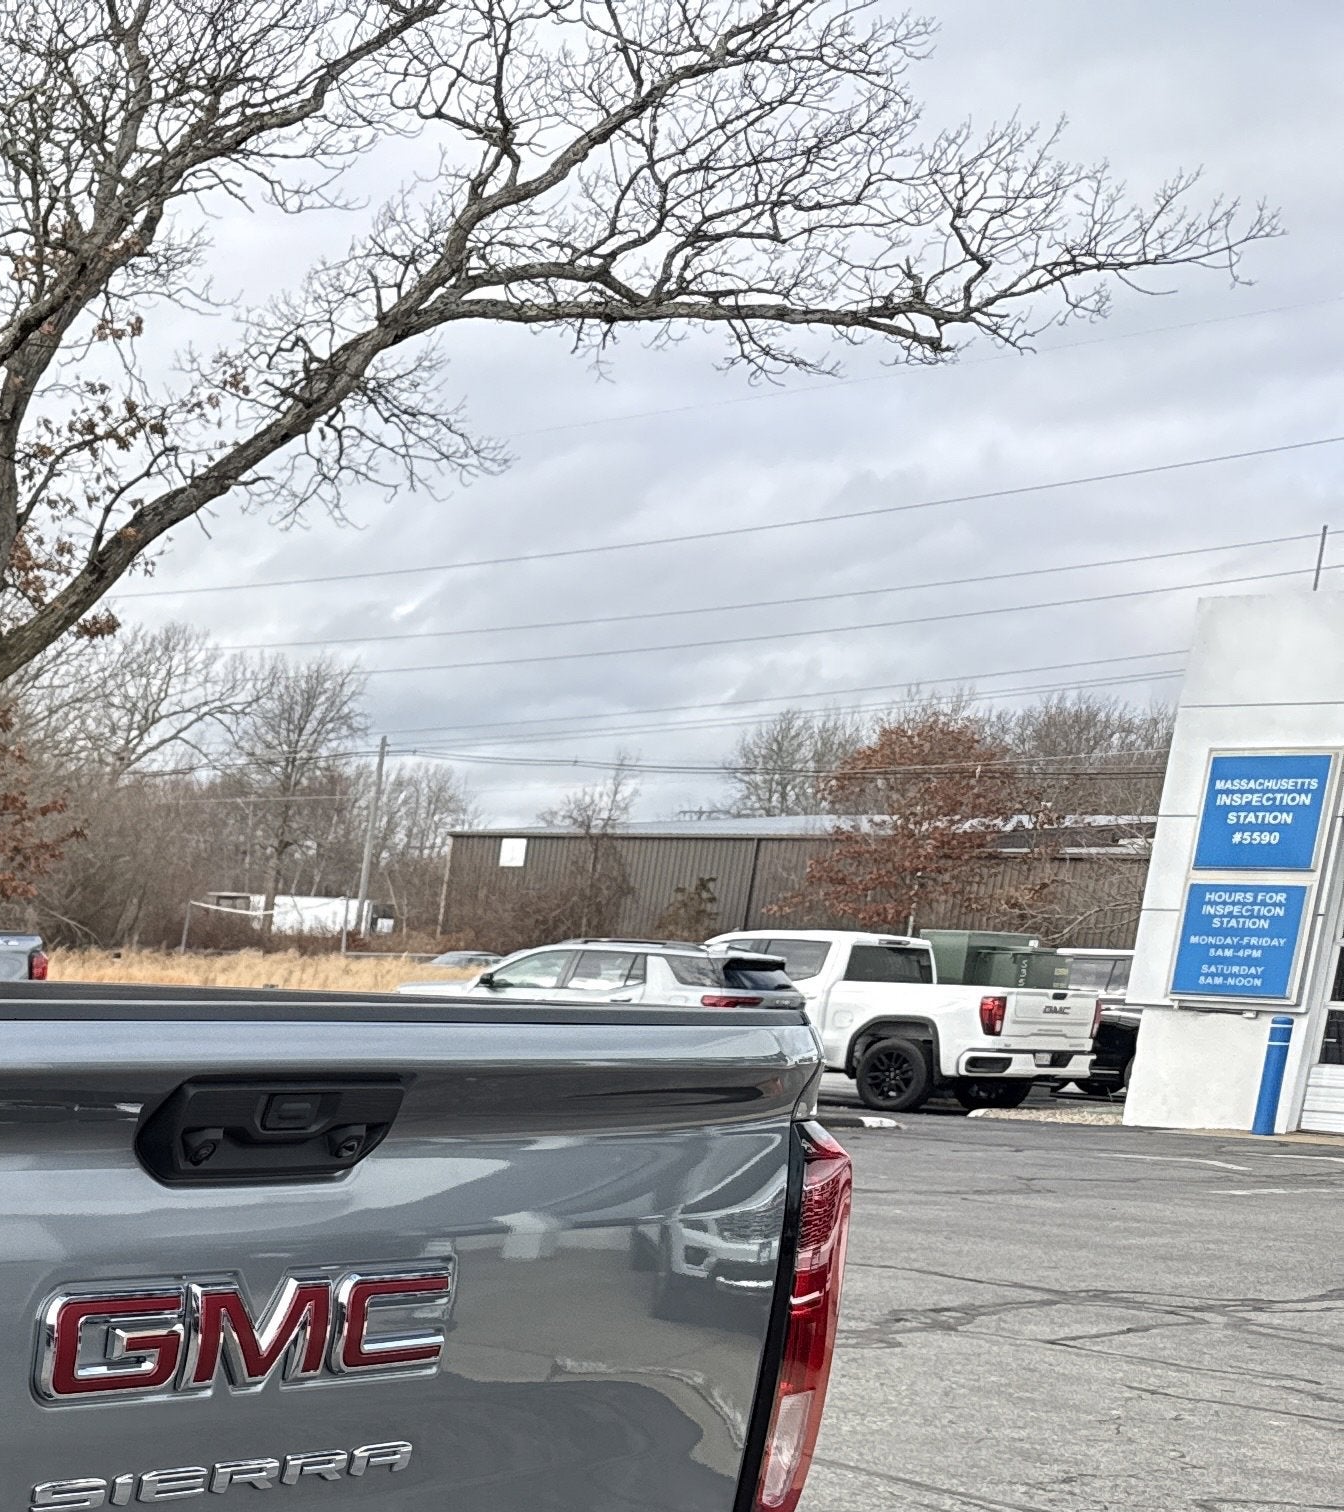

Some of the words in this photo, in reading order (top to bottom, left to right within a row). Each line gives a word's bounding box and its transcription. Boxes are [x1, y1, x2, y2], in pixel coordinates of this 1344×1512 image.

[1214, 778, 1319, 790] MASSACHUSETTS
[1216, 792, 1312, 806] INSPECTION
[1226, 811, 1294, 825] STATION
[1231, 831, 1281, 845] #5590
[1205, 891, 1254, 903] HOURS
[1257, 892, 1287, 904] FOR
[1201, 904, 1285, 917] INSPECTION
[1211, 917, 1270, 929] STATION
[1189, 935, 1287, 947] MONDAY-FRIDAY
[1200, 964, 1265, 975] SATURDAY
[31, 1257, 456, 1408] GMC
